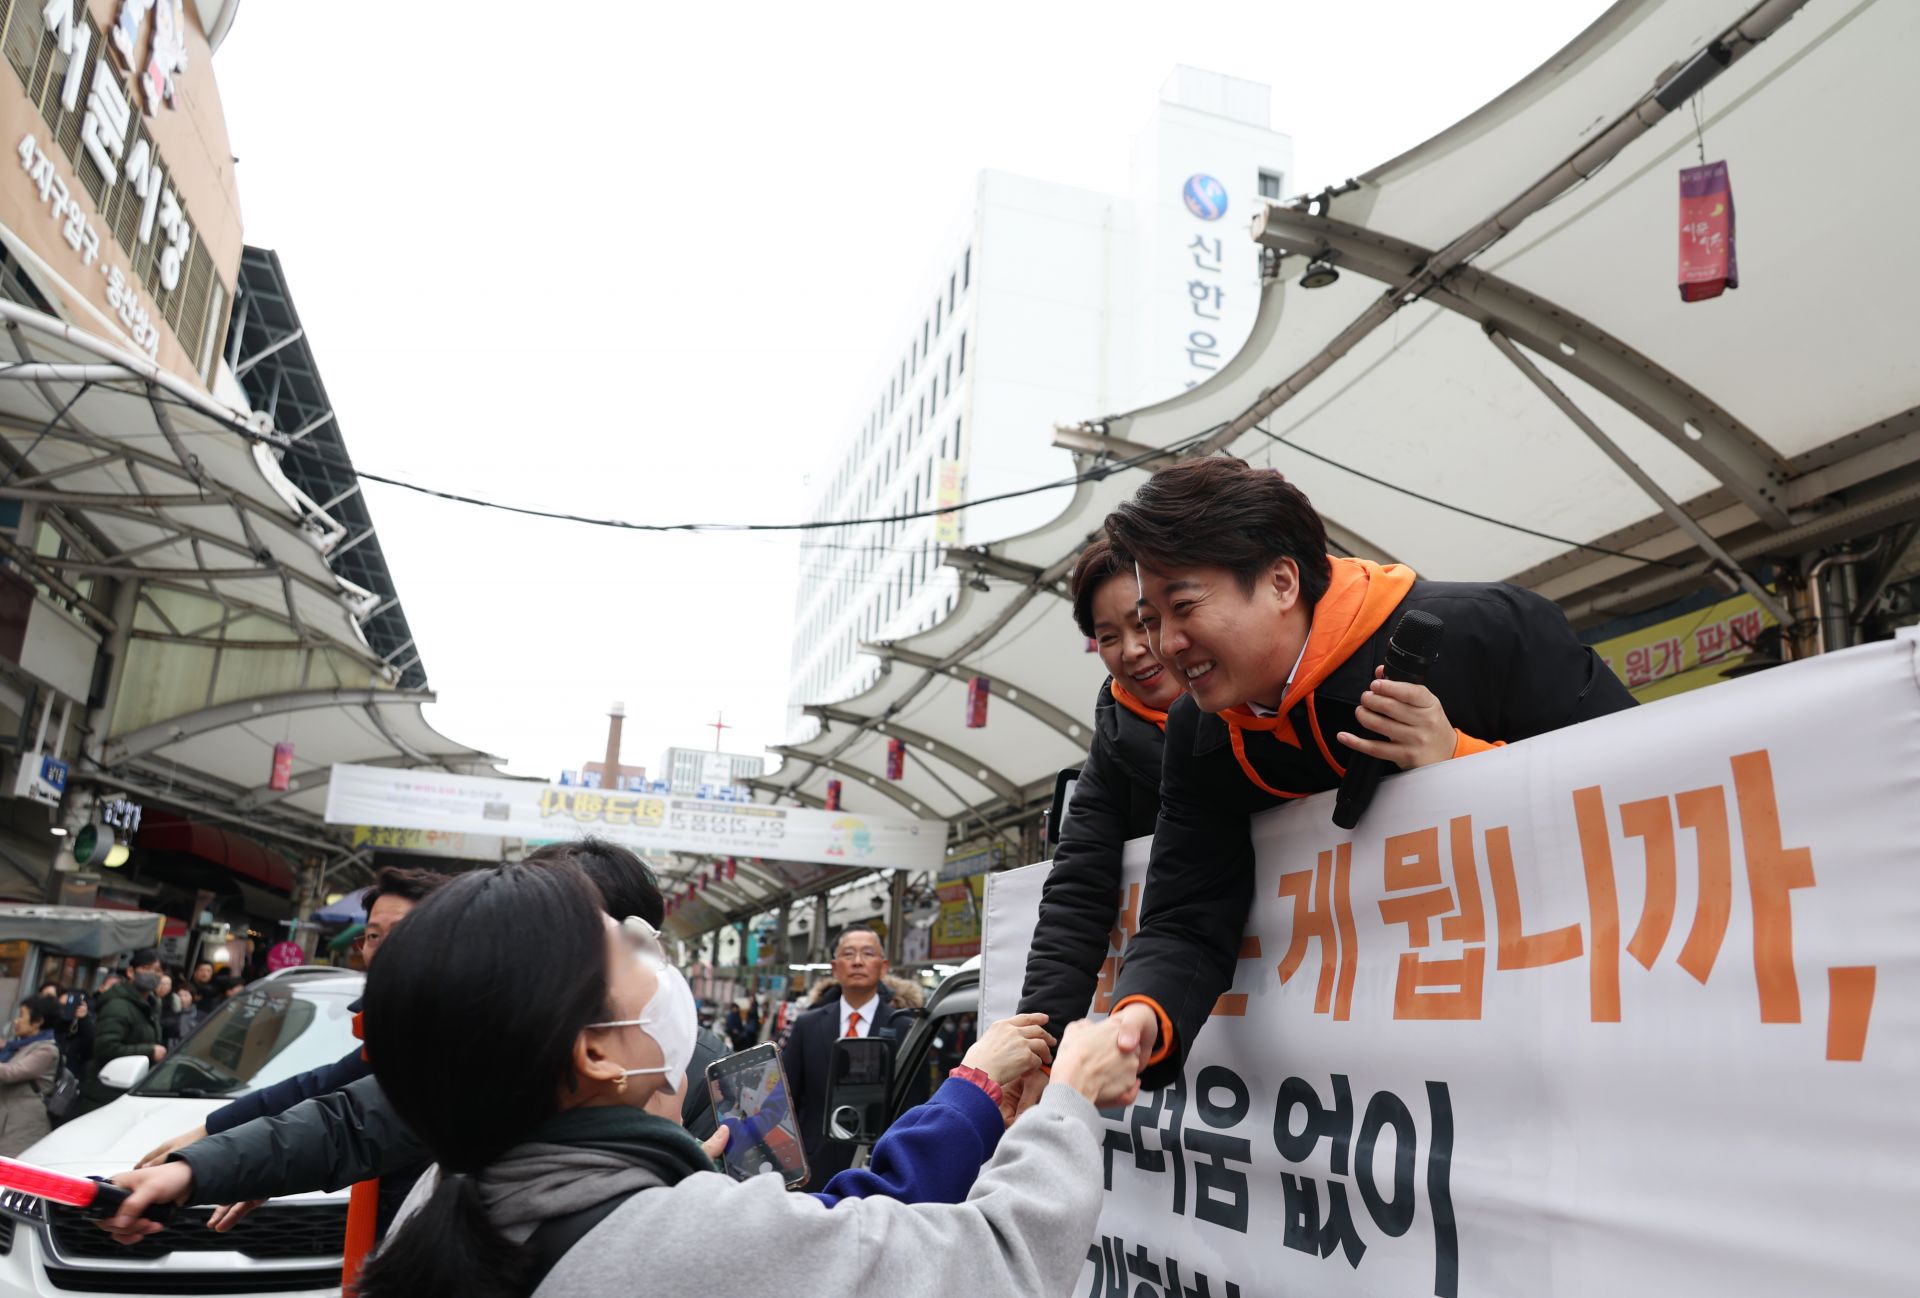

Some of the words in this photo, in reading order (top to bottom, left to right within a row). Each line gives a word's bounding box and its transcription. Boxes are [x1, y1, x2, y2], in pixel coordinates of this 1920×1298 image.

[18, 133, 100, 266] 4지구입구
[43, 0, 190, 291] 서문시장
[1625, 637, 1684, 687] 원가
[1277, 842, 1357, 1021] 게
[1377, 749, 1876, 1062] 뭡니까,
[1273, 1073, 1459, 1297] 없이
